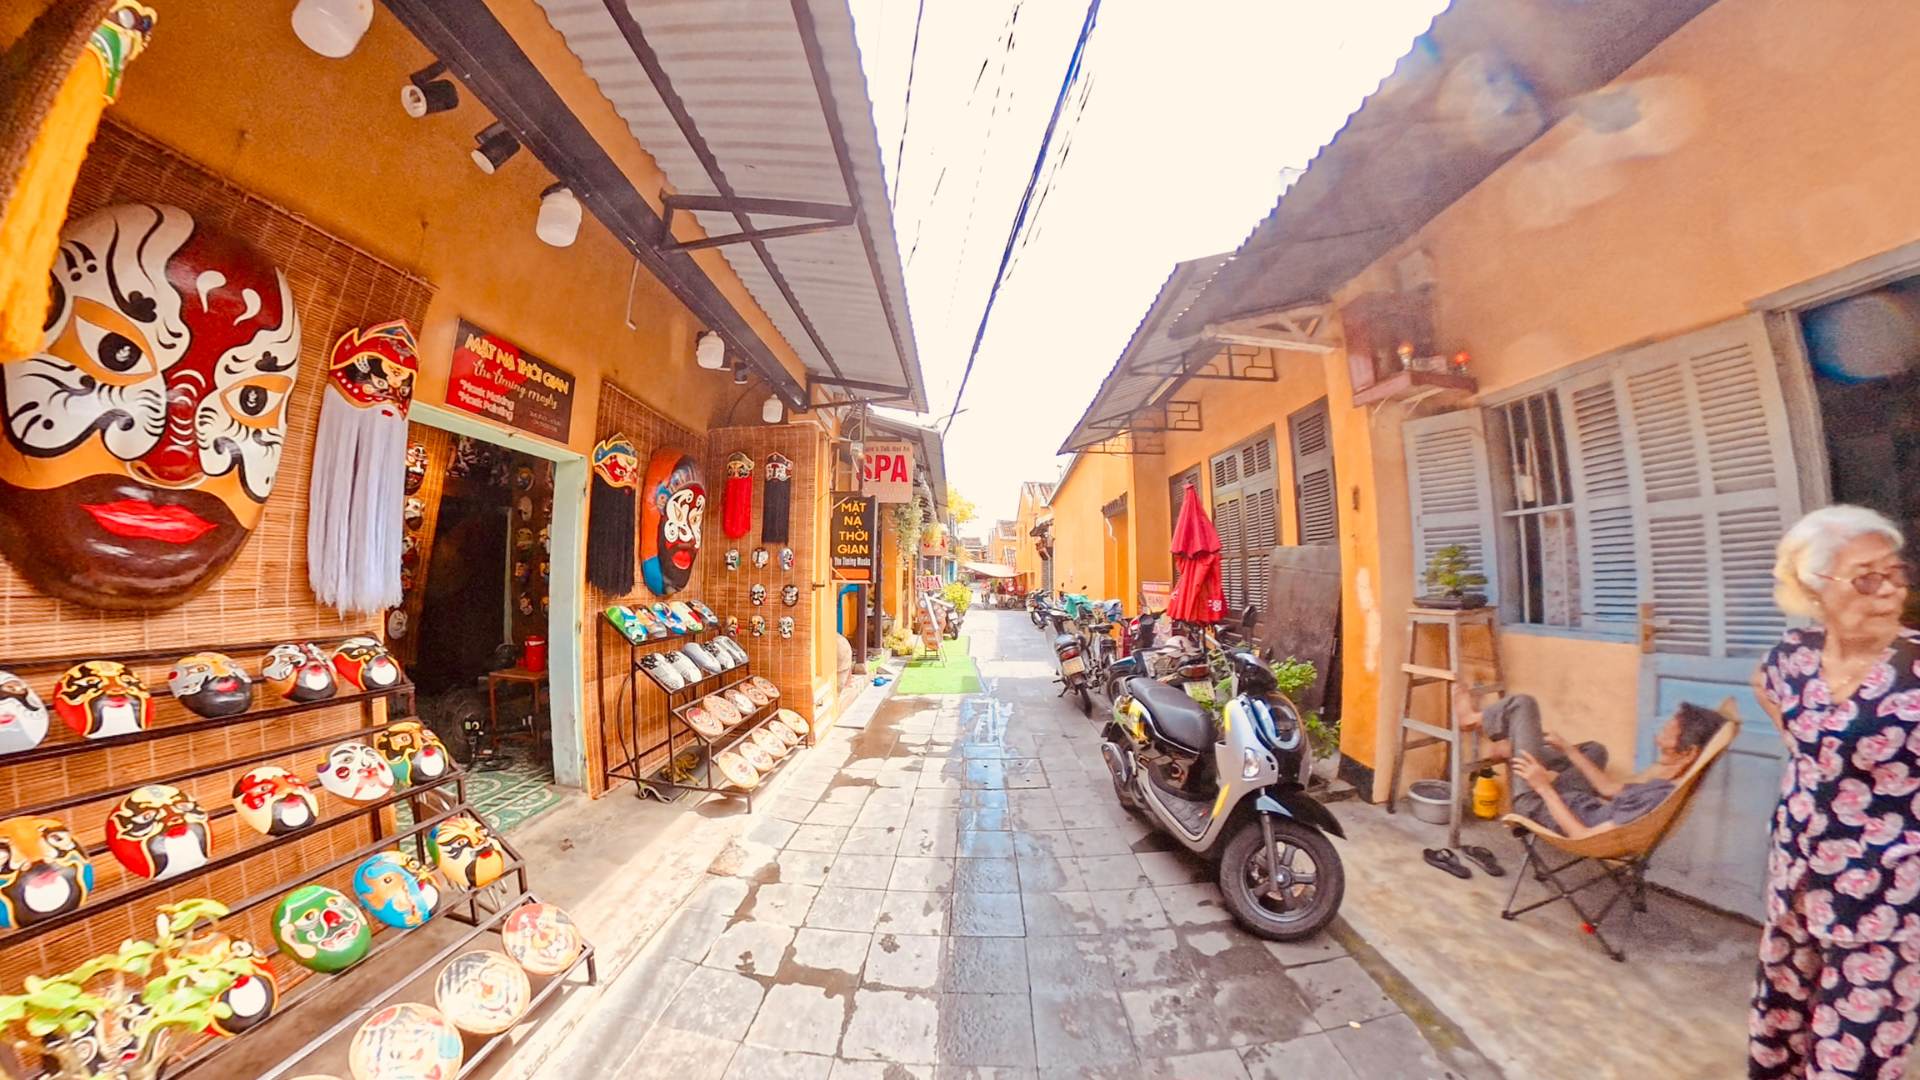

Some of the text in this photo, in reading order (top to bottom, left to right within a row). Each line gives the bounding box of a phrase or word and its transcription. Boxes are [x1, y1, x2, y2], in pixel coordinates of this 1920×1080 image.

[542, 372, 570, 395] GIAN
[856, 454, 908, 482] SPA
[841, 500, 867, 515] MẶT
[843, 516, 862, 529] NẠ
[839, 527, 868, 542] THỜI
[837, 544, 869, 555] GIAN
